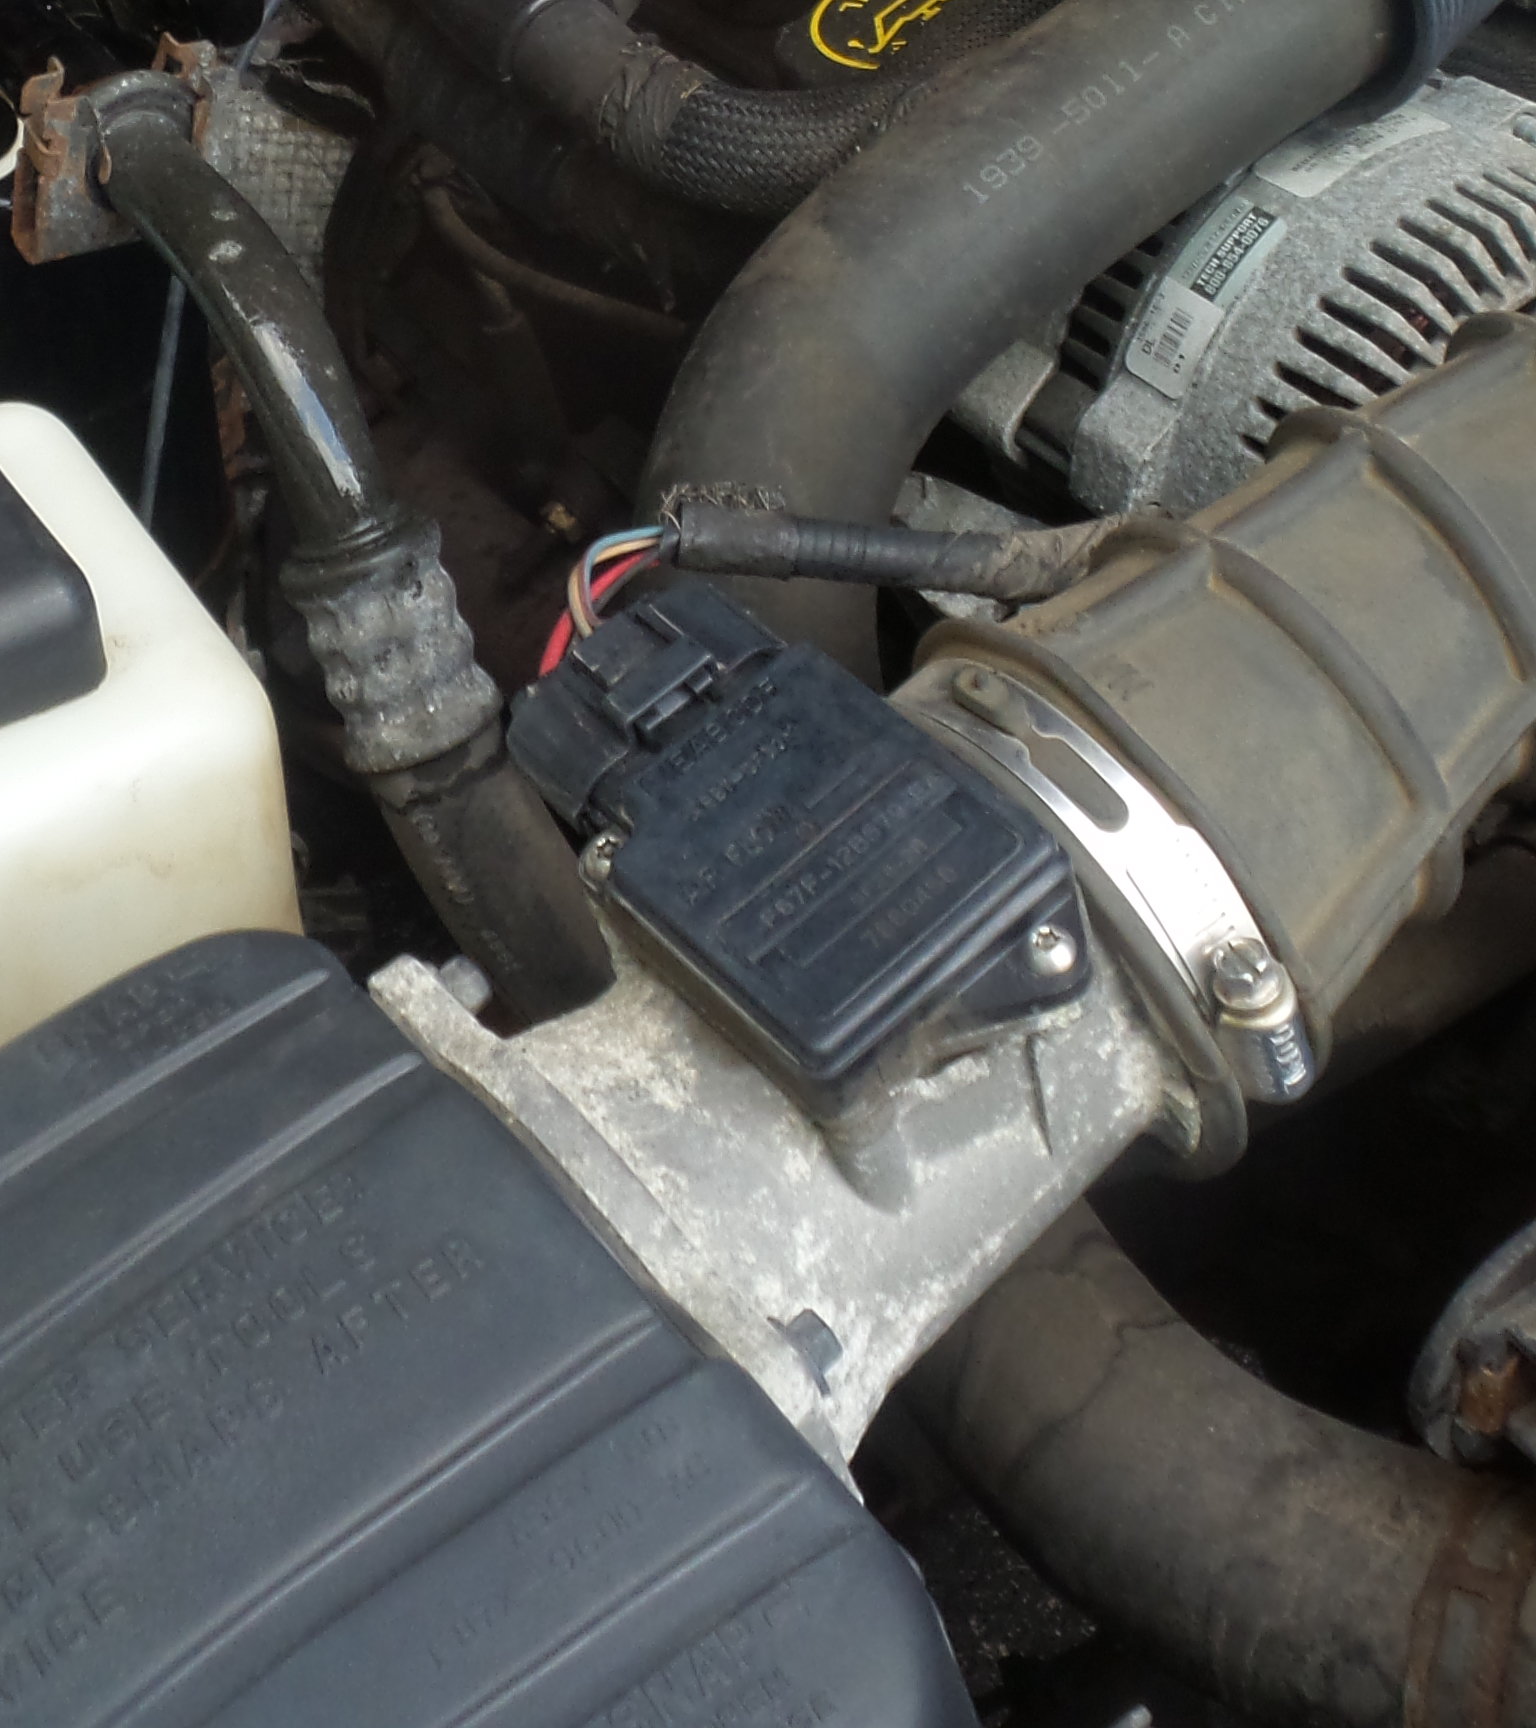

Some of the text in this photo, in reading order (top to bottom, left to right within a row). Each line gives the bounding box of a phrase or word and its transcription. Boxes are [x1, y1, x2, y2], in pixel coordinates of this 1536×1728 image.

[1197, 255, 1222, 288] TECH
[1217, 213, 1258, 258] SUPPORT
[310, 1238, 487, 1375] AFTER
